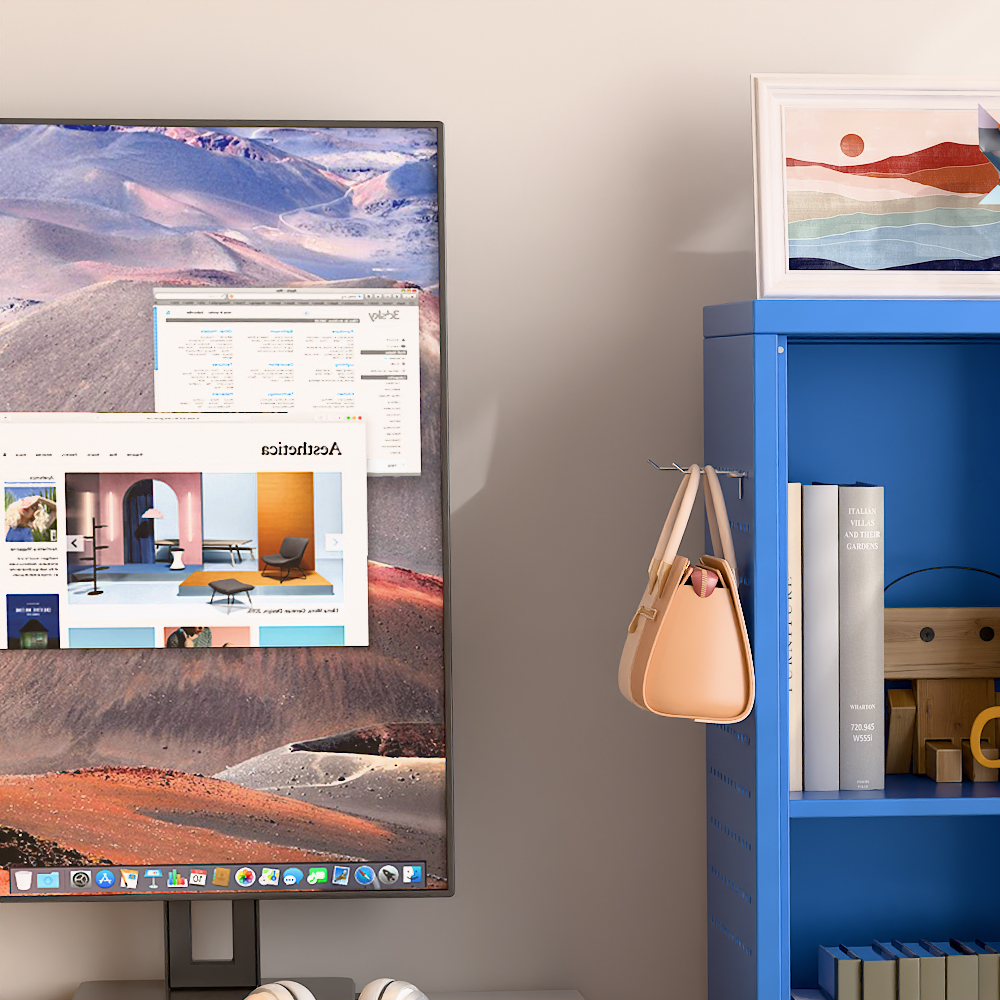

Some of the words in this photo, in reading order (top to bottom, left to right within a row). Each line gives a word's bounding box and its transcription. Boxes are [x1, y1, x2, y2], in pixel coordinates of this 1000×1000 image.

[848, 507, 877, 515] ITALIAN
[850, 519, 875, 527] VILLAS
[846, 542, 879, 550] GARDENS
[850, 723, 875, 731] 720.945
[852, 734, 873, 742] W555i
